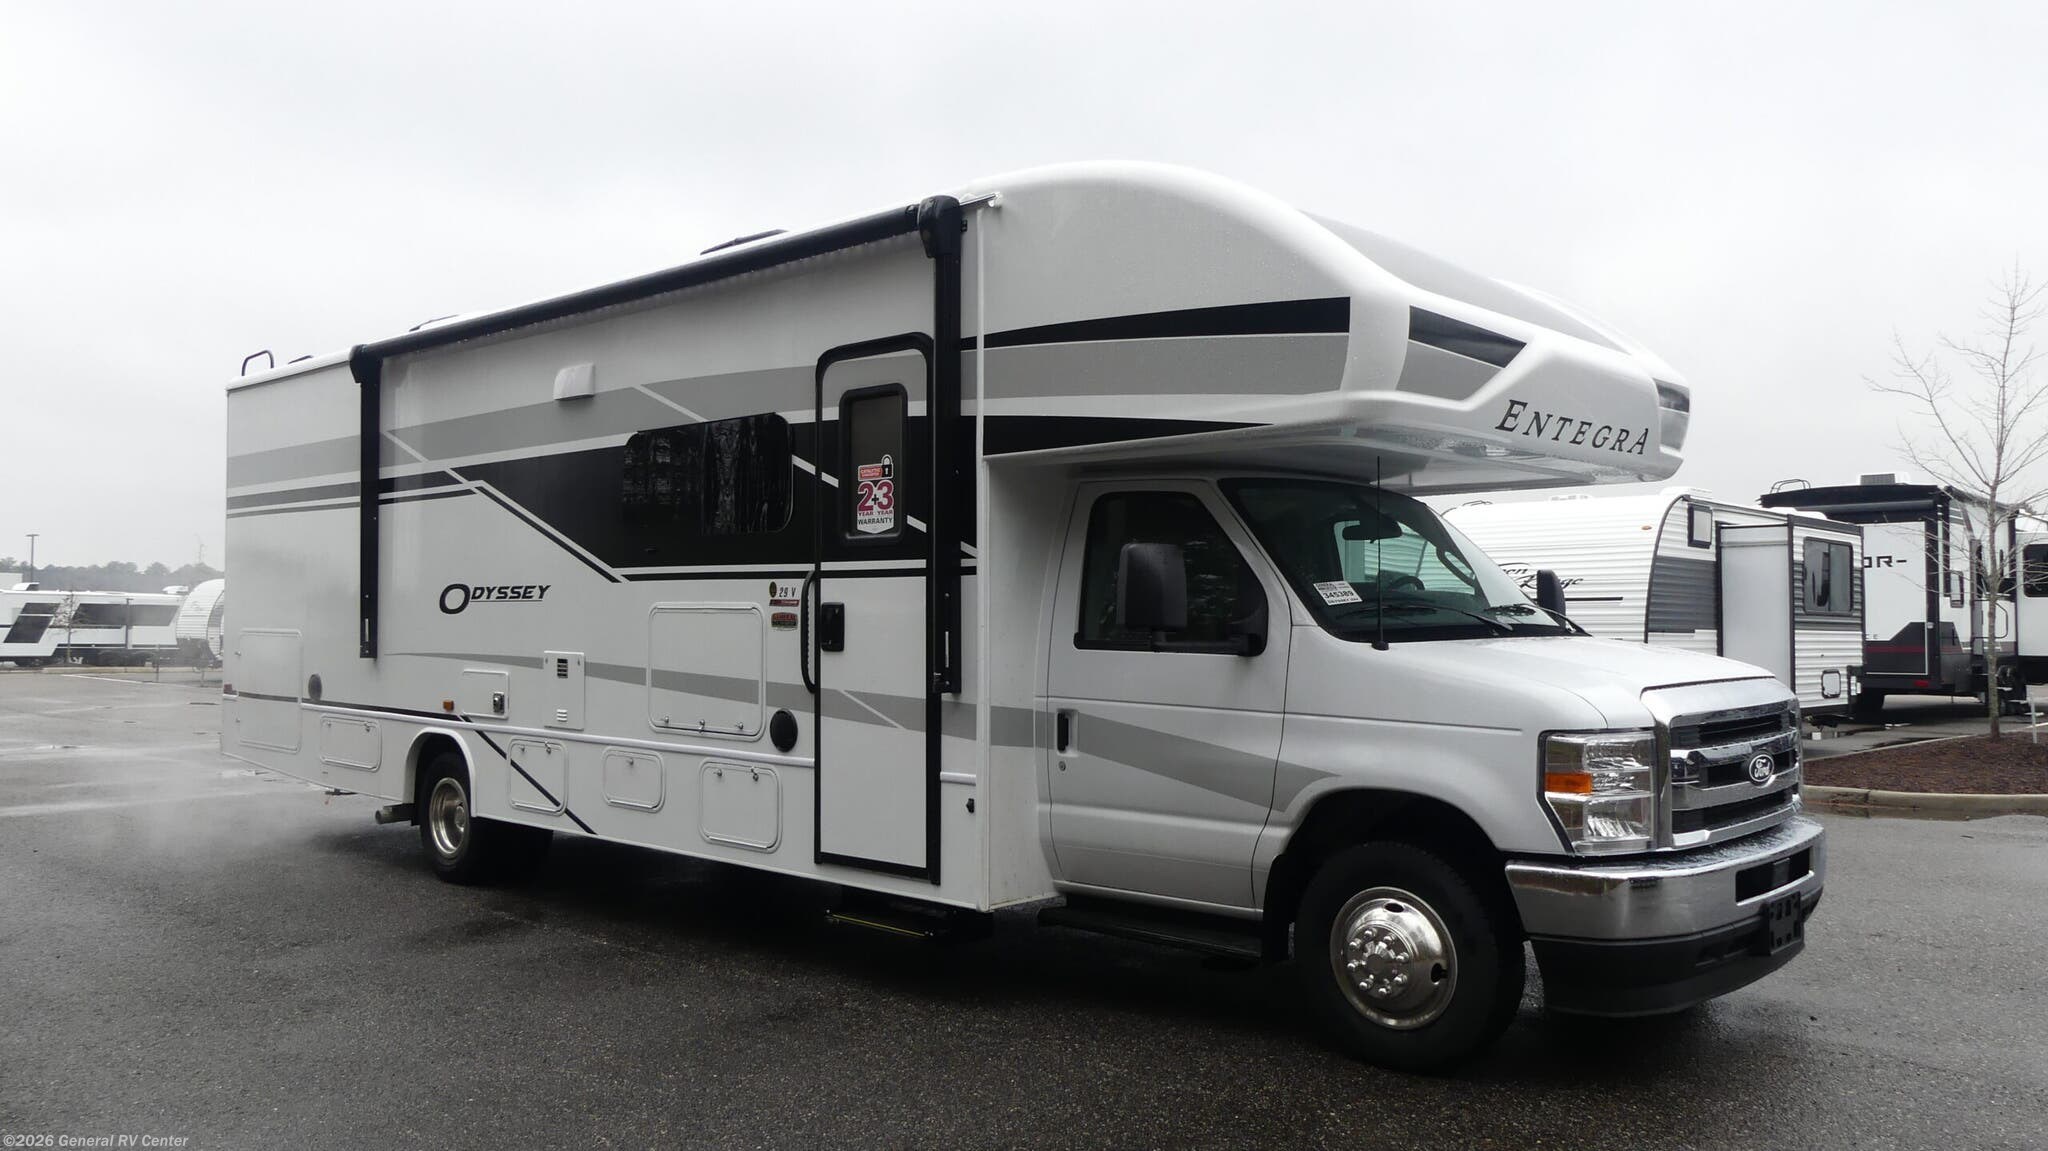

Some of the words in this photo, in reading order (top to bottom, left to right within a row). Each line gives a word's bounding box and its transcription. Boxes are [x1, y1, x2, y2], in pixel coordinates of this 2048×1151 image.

[1495, 399, 1649, 455] ENTEGRA
[858, 517, 893, 525] WARRANTY
[439, 583, 551, 615] ODYSSEY
[779, 586, 788, 598] 29
